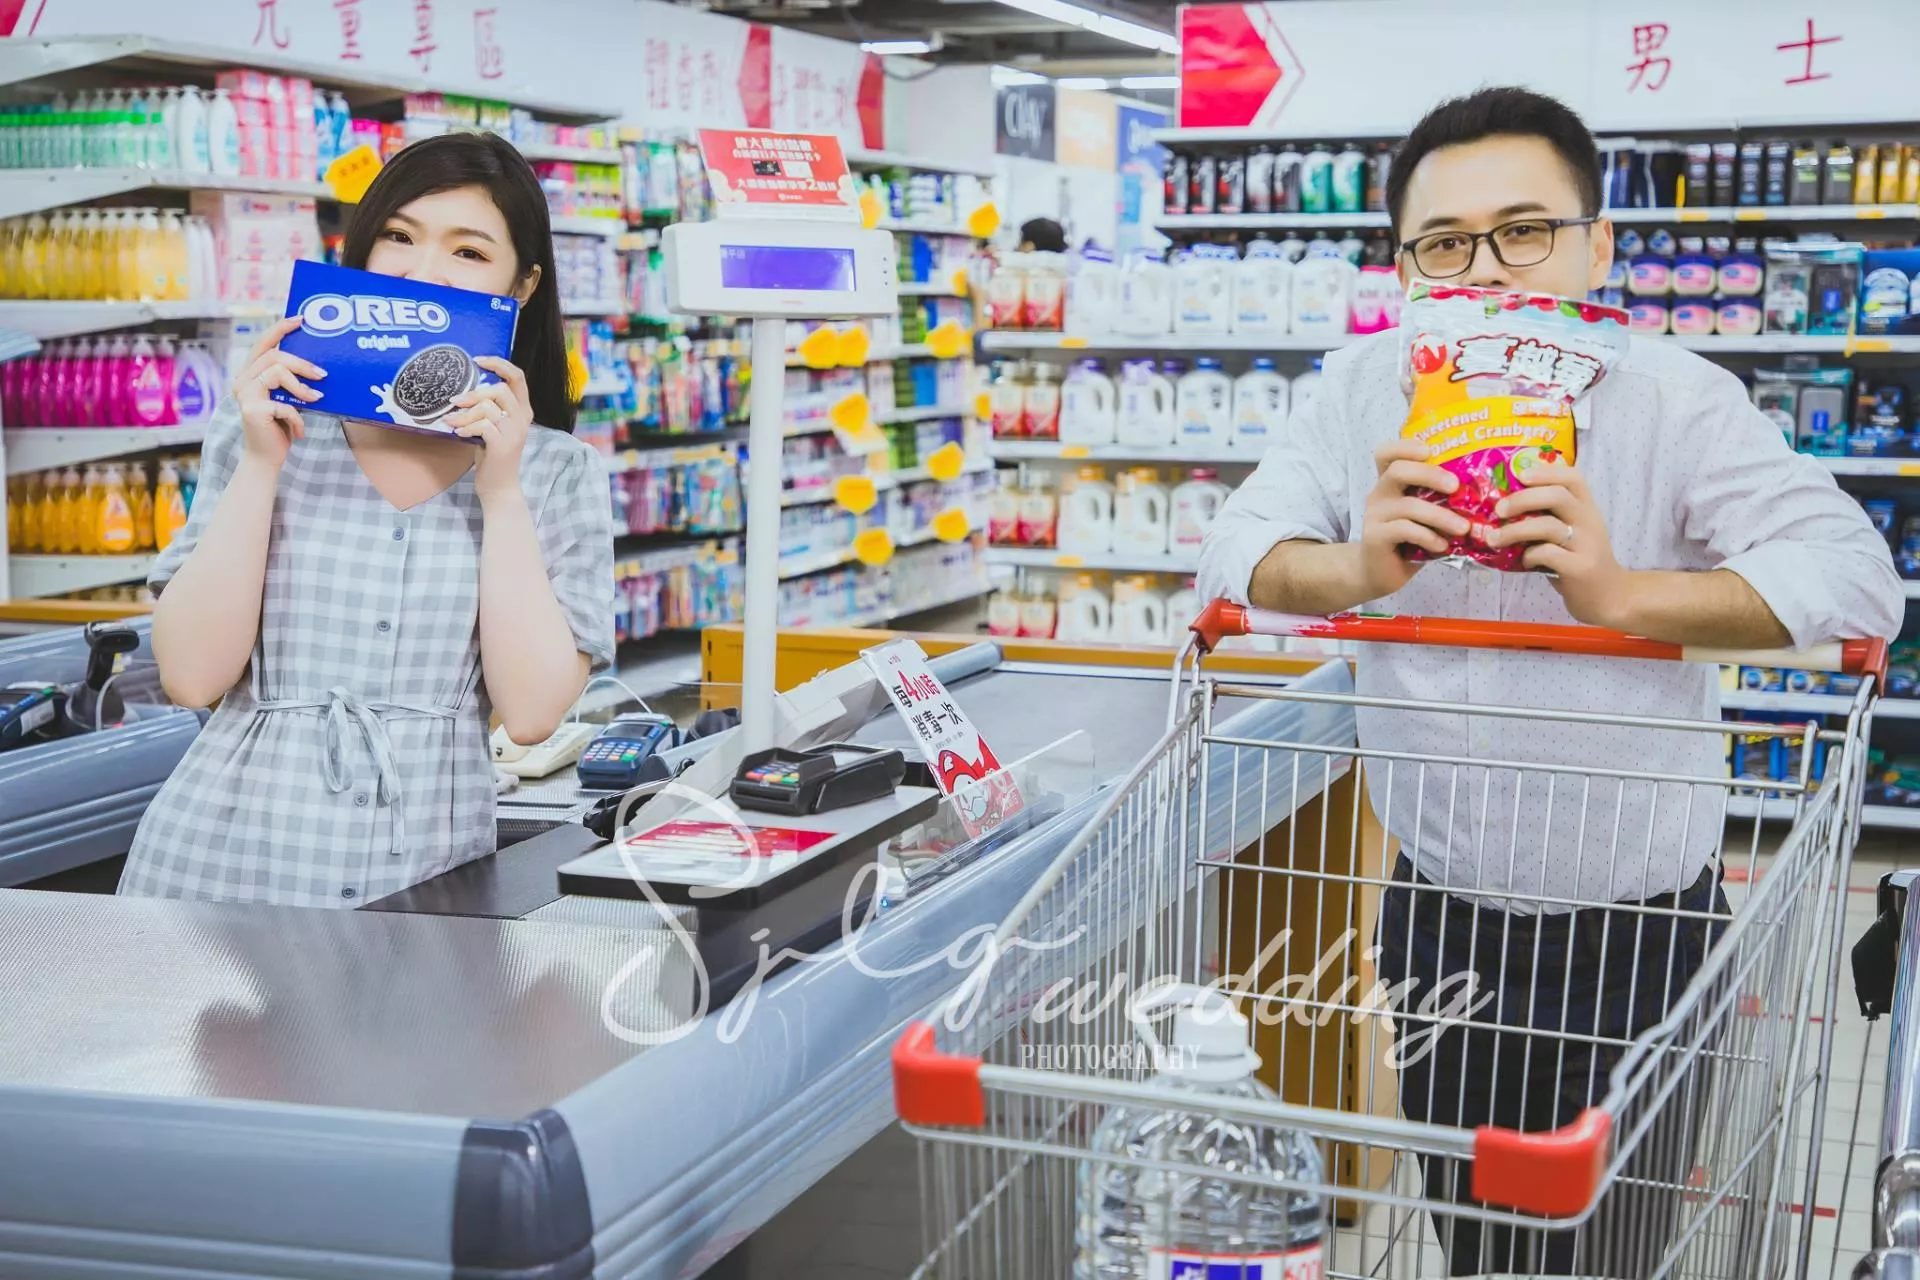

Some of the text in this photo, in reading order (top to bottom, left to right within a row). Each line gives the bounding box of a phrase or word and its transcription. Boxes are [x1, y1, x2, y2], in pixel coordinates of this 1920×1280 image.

[1624, 17, 1844, 93] 男士
[300, 295, 449, 335] OREO
[357, 335, 411, 352] Original
[1448, 336, 1602, 404] 蔓越莓
[1413, 406, 1490, 443] Sweetened
[1430, 423, 1558, 457] Dried Cranberry
